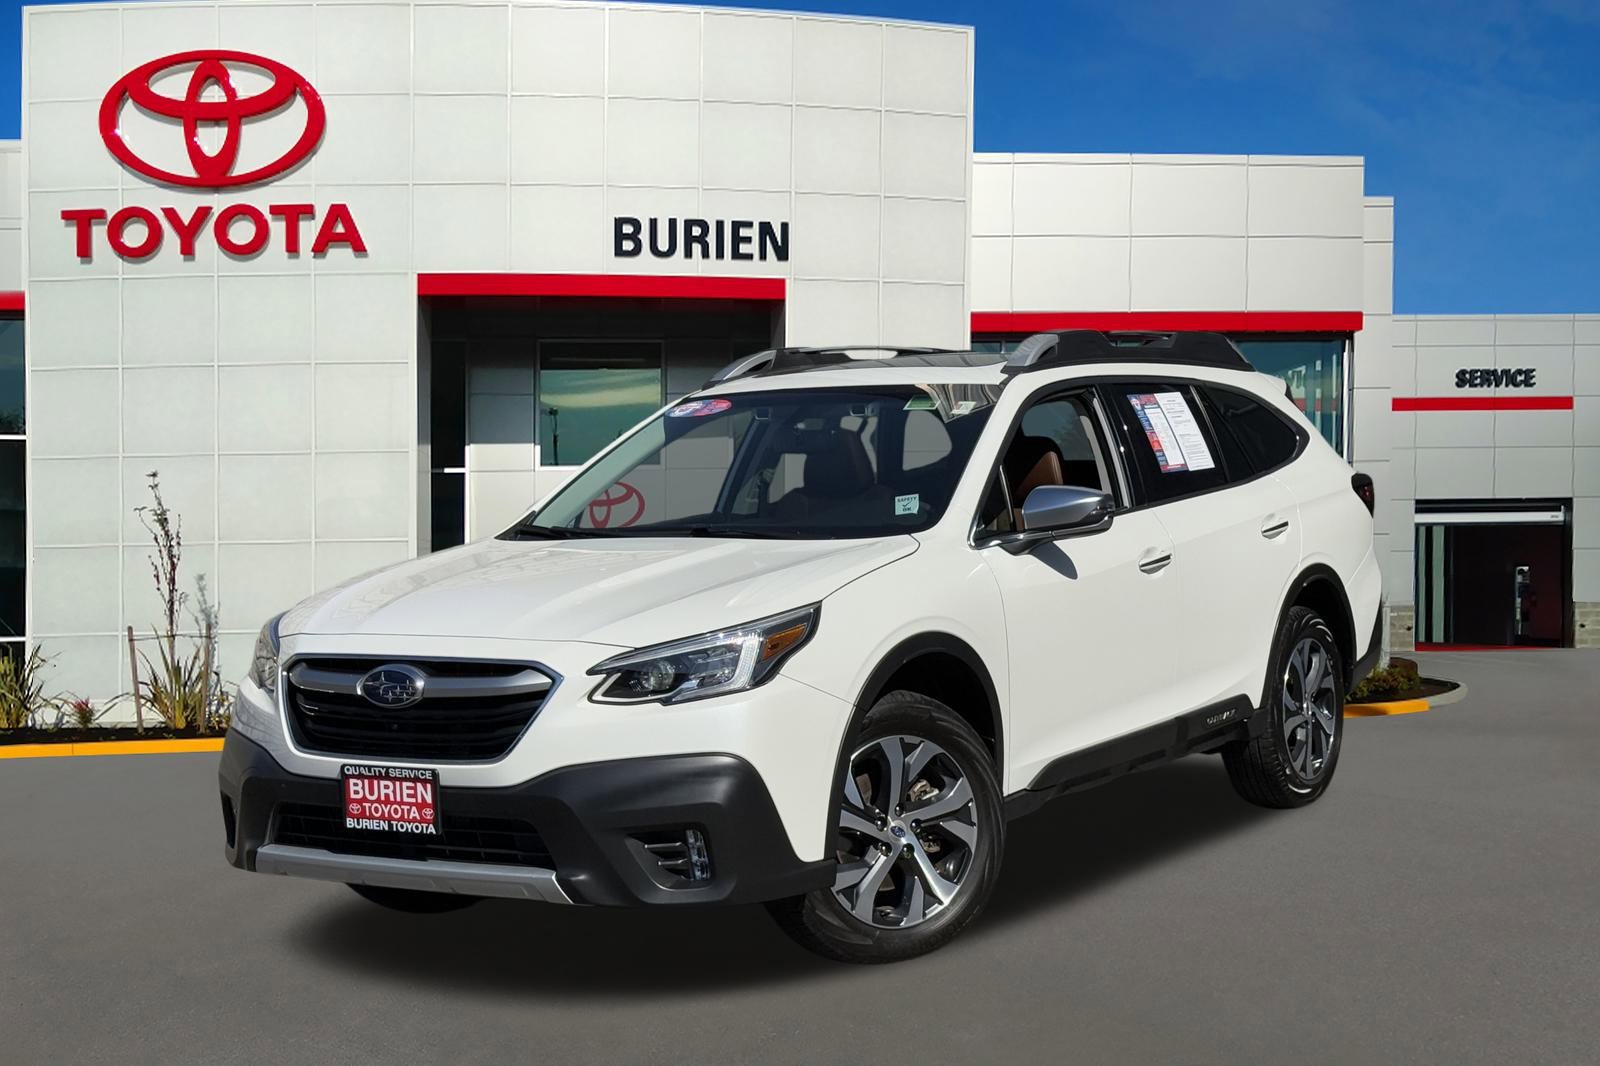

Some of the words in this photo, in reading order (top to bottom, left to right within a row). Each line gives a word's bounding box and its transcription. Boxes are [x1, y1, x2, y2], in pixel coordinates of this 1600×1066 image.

[61, 204, 368, 259] TOYOTA
[614, 217, 790, 262] BURIEN
[1455, 368, 1536, 388] SERVICE
[344, 765, 386, 776] QUALITY
[389, 768, 433, 779] SERVICE
[349, 778, 432, 804] BURIEN
[363, 802, 420, 820] TOYOTA
[346, 817, 389, 831] BURIEN
[391, 820, 436, 834] TOYOTA
